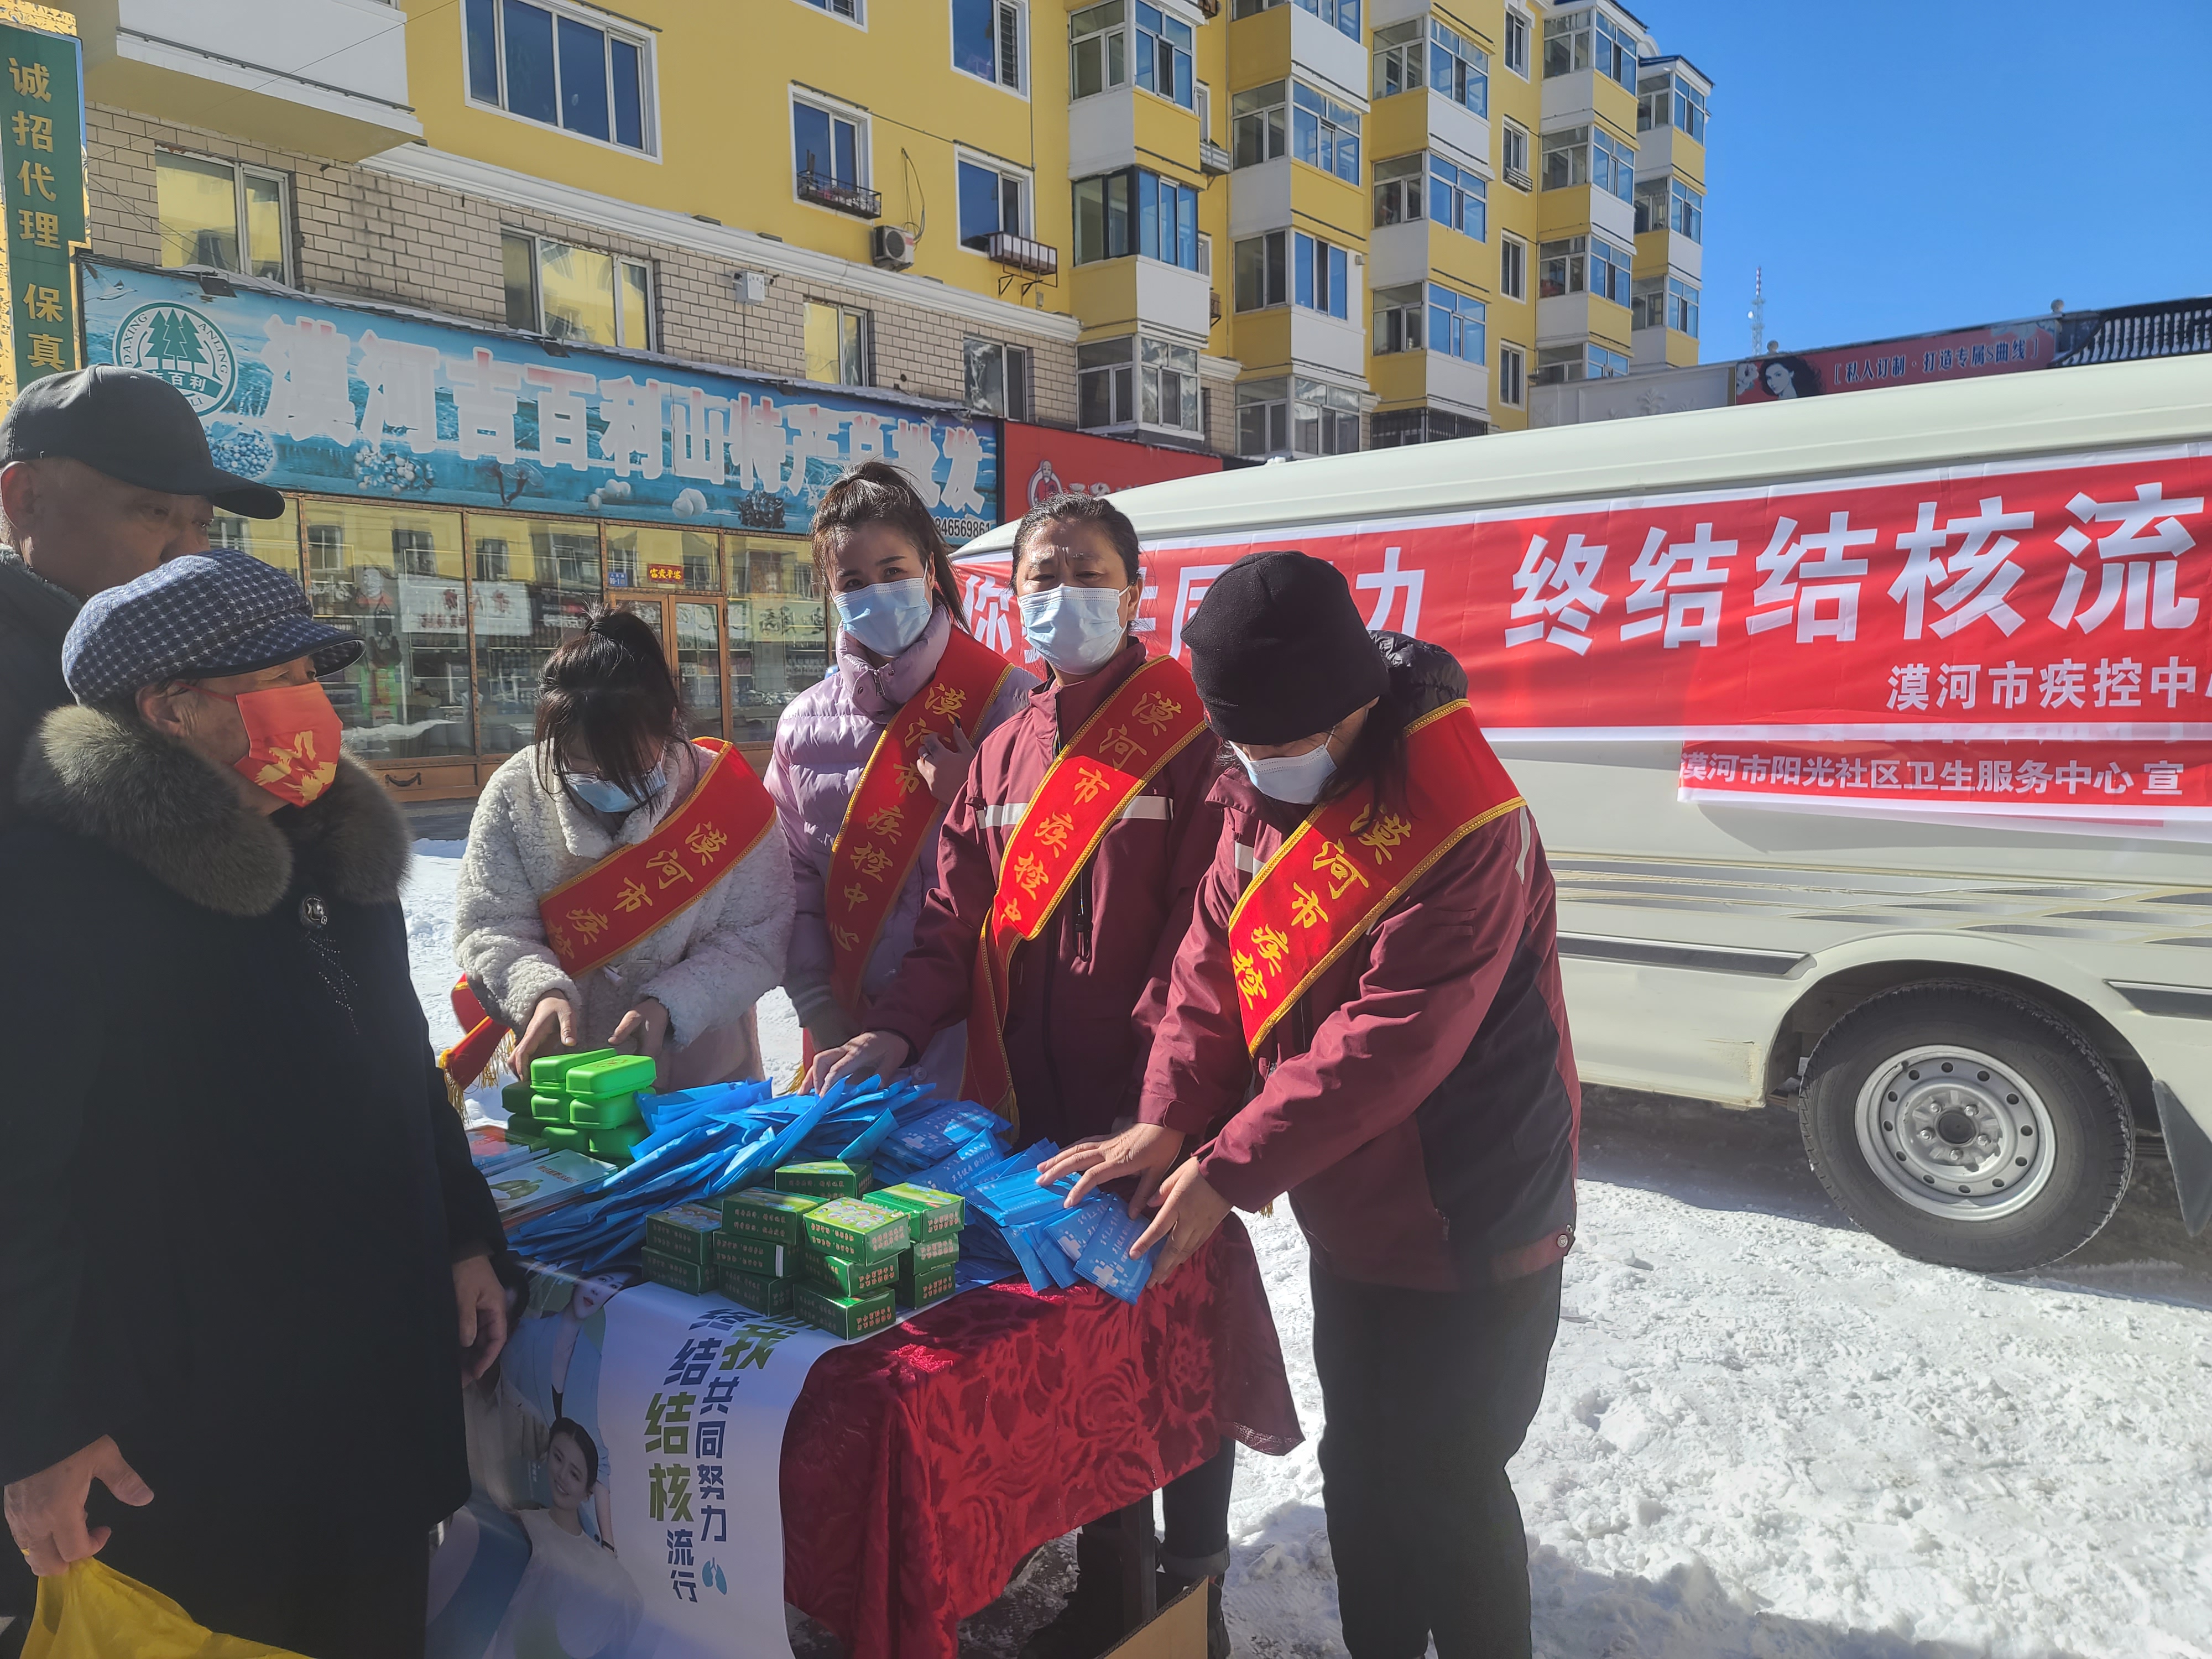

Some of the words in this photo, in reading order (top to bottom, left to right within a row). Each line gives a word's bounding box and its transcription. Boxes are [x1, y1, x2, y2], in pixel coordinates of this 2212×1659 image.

[123, 314, 148, 365] DAXING
[199, 323, 228, 374] ANLING
[1886, 656, 2212, 711] 漠河市疾控中
[1679, 751, 2135, 795] 漠河市阳光社区卫生服务中心
[2142, 760, 2184, 796] 宣
[643, 1308, 764, 1604] 终结结核流行
